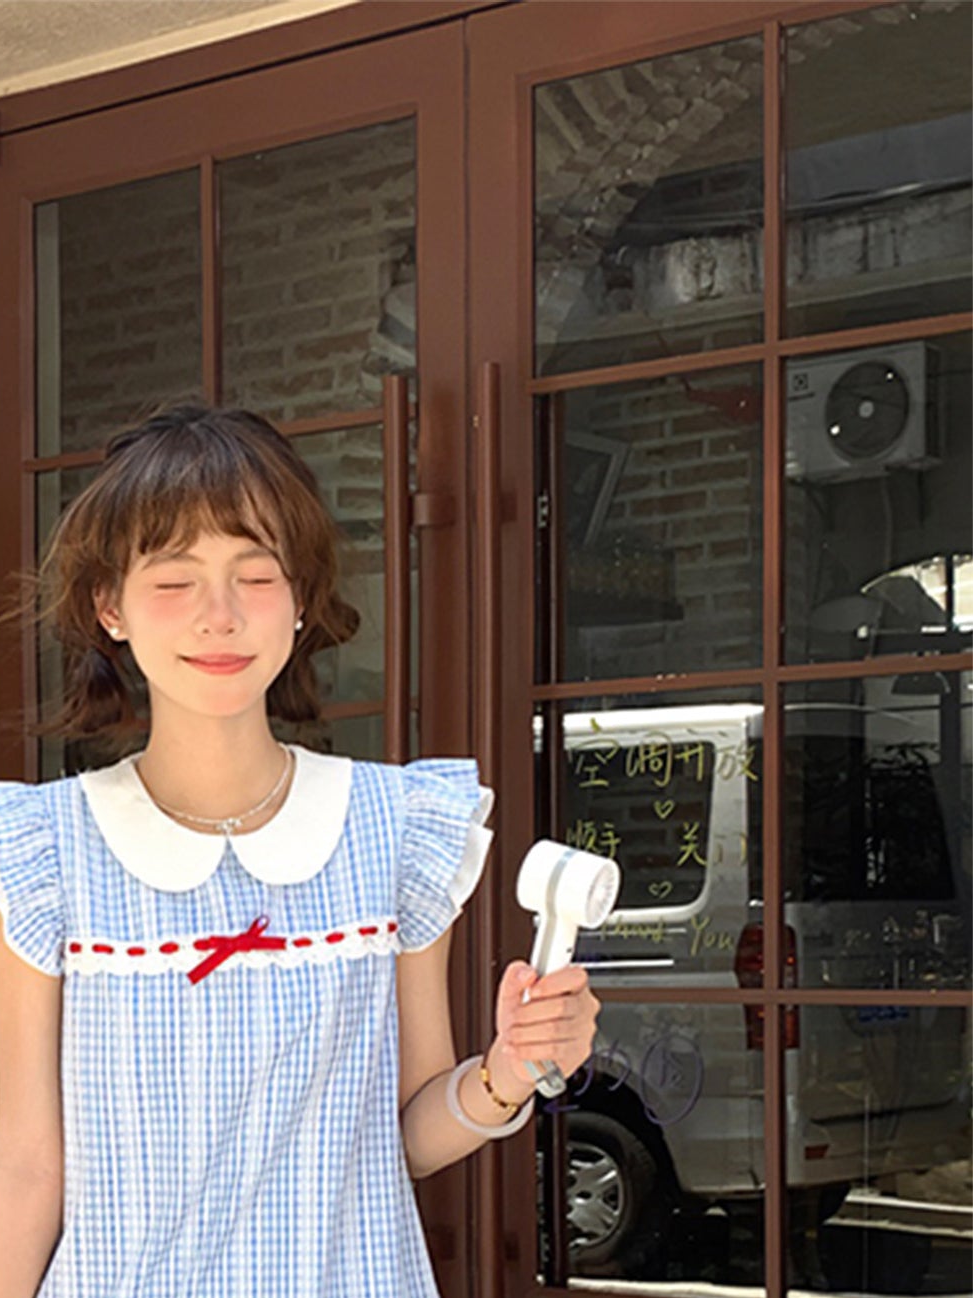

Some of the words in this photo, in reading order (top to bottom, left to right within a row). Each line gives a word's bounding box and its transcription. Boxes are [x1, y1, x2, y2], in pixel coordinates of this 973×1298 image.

[568, 717, 758, 787] 空调开放
[691, 914, 734, 956] You
